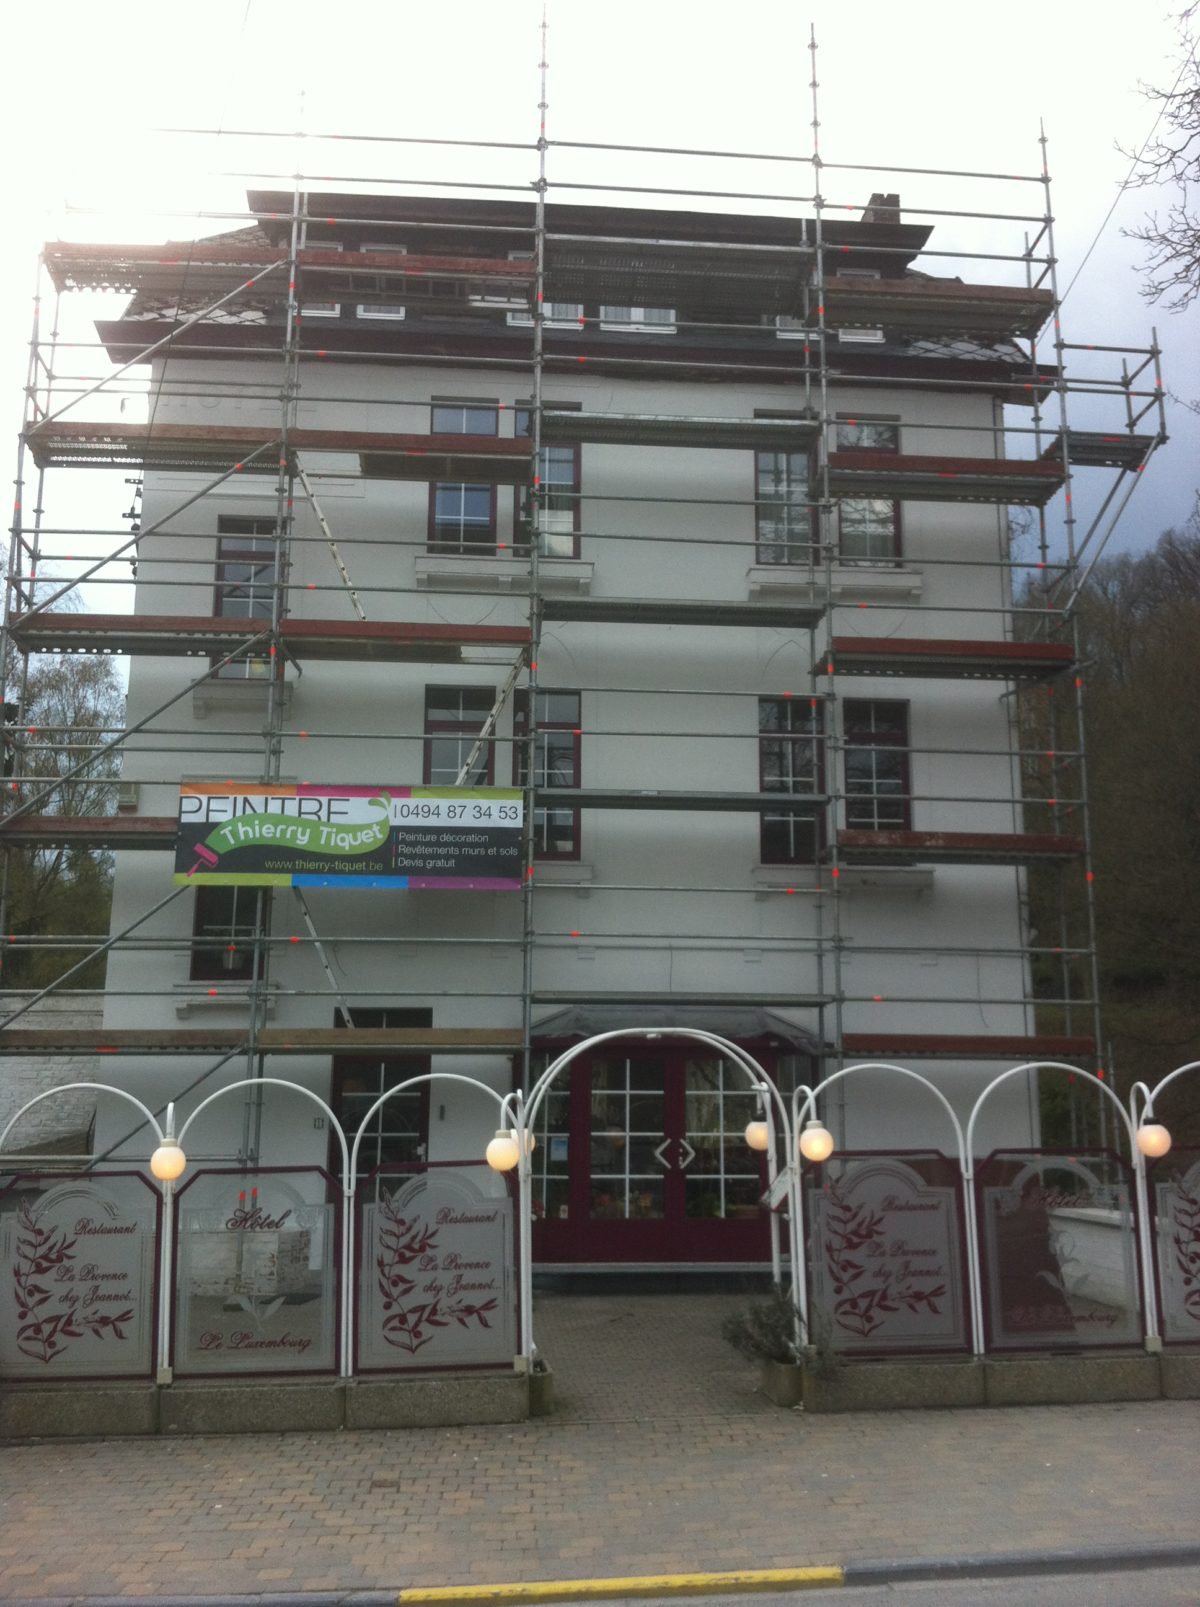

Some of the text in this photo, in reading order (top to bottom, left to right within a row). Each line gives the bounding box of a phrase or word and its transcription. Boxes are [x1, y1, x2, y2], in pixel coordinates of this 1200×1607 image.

[179, 795, 350, 823] PEINTRE
[400, 804, 518, 820] 0494 87 34 53
[220, 820, 383, 850] Thierry Tiquet
[398, 832, 489, 843] Peinture décoration
[398, 845, 518, 856] Revêtements murs et sols
[264, 859, 384, 872] www.thierry-tiquet.be
[398, 858, 456, 868] Devis gratuit
[881, 1195, 942, 1211] Restaurant
[225, 1208, 293, 1231] Hôtel
[435, 1206, 498, 1225] Restaurant
[74, 1217, 138, 1236] Restaurant
[417, 1253, 492, 1272] La Provence
[54, 1263, 129, 1282] La Provence
[422, 1277, 444, 1298] chez
[58, 1287, 80, 1308] chez
[199, 1331, 313, 1354] Le Luxembourg
